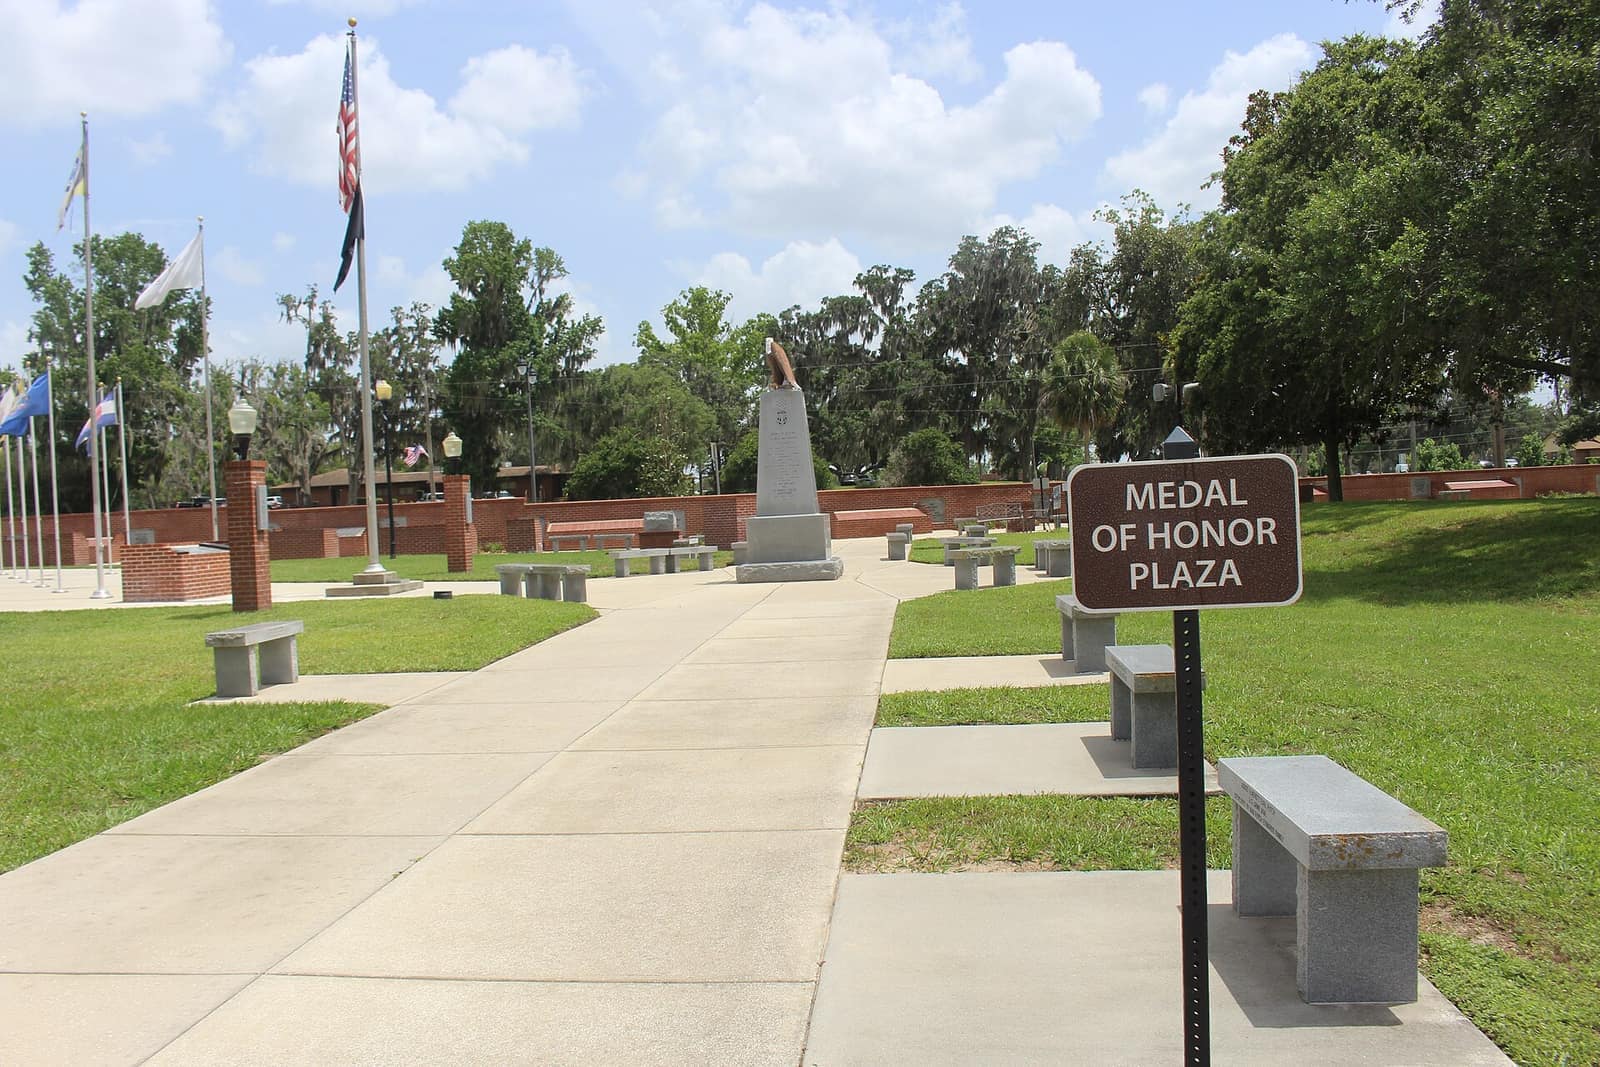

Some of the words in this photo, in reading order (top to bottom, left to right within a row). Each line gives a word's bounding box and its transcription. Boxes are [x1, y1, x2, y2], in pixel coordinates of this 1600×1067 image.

[1126, 478, 1248, 511] MEDAL
[1091, 523, 1137, 552] OF
[1147, 517, 1278, 550] HONOR
[1129, 559, 1243, 590] PLAZA
